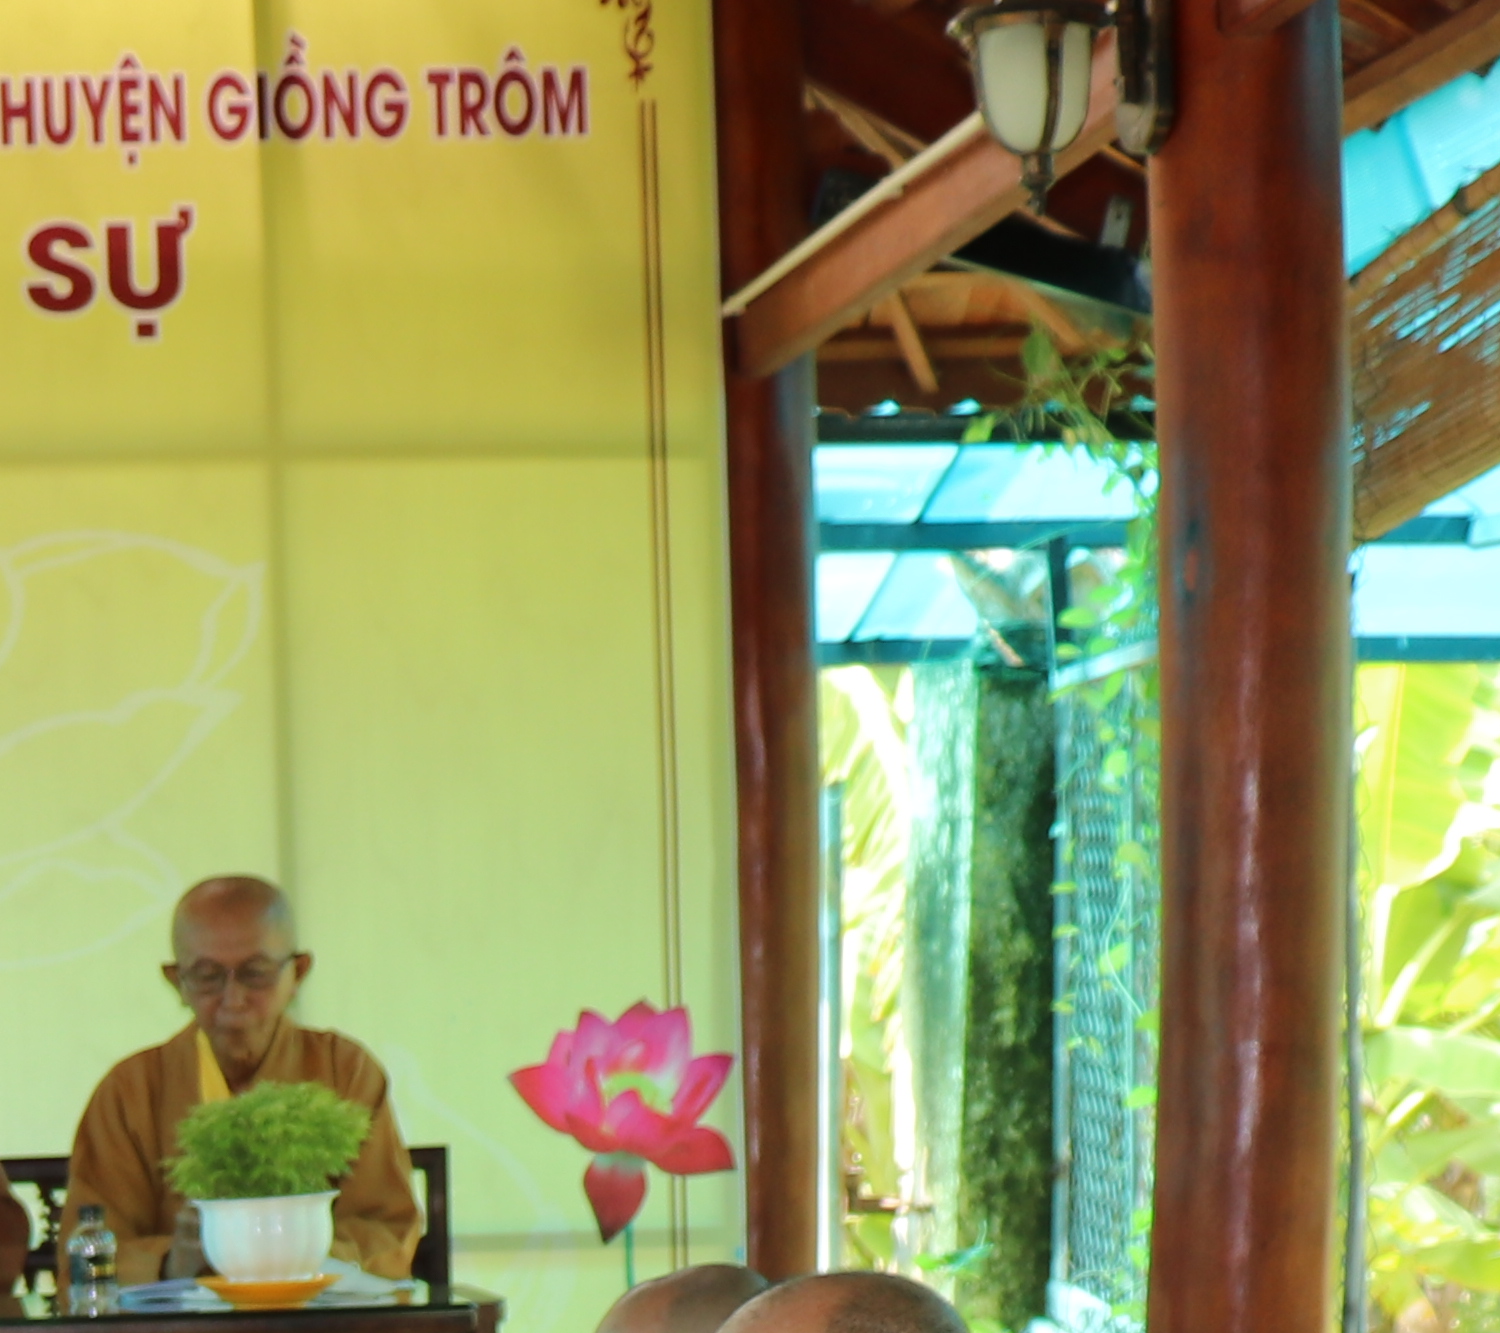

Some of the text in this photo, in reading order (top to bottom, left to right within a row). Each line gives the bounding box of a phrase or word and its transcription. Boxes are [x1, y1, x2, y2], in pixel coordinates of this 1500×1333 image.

[1, 55, 185, 167] HUYỆN
[208, 32, 408, 141] GIỒNG
[428, 48, 588, 138] TRÔM
[27, 206, 192, 338] SỰ
